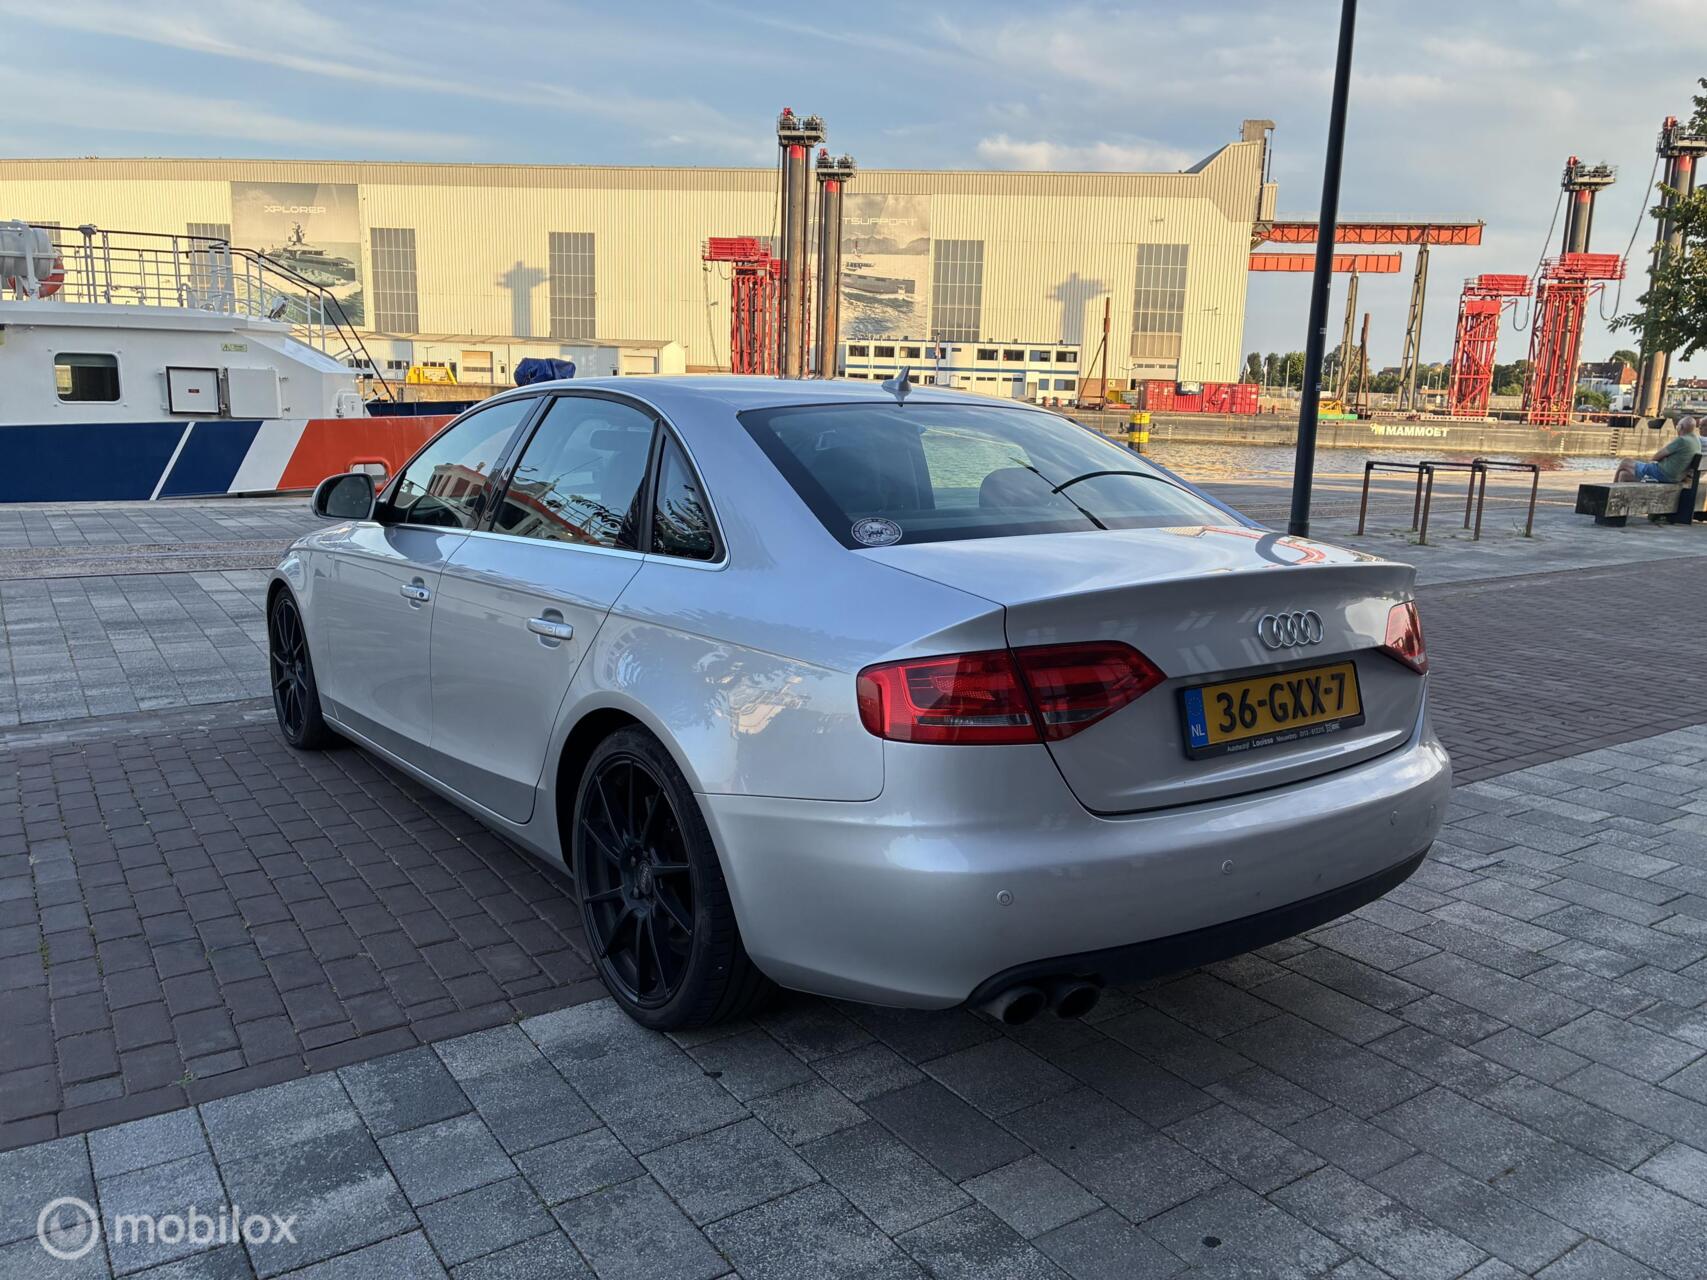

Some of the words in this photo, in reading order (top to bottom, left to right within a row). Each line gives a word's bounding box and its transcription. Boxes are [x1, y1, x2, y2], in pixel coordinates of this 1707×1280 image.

[264, 205, 326, 214] XPLORER
[1386, 425, 1449, 437] MAMMOET
[1216, 672, 1346, 733] 36-GXX-7
[1191, 724, 1205, 737] NL
